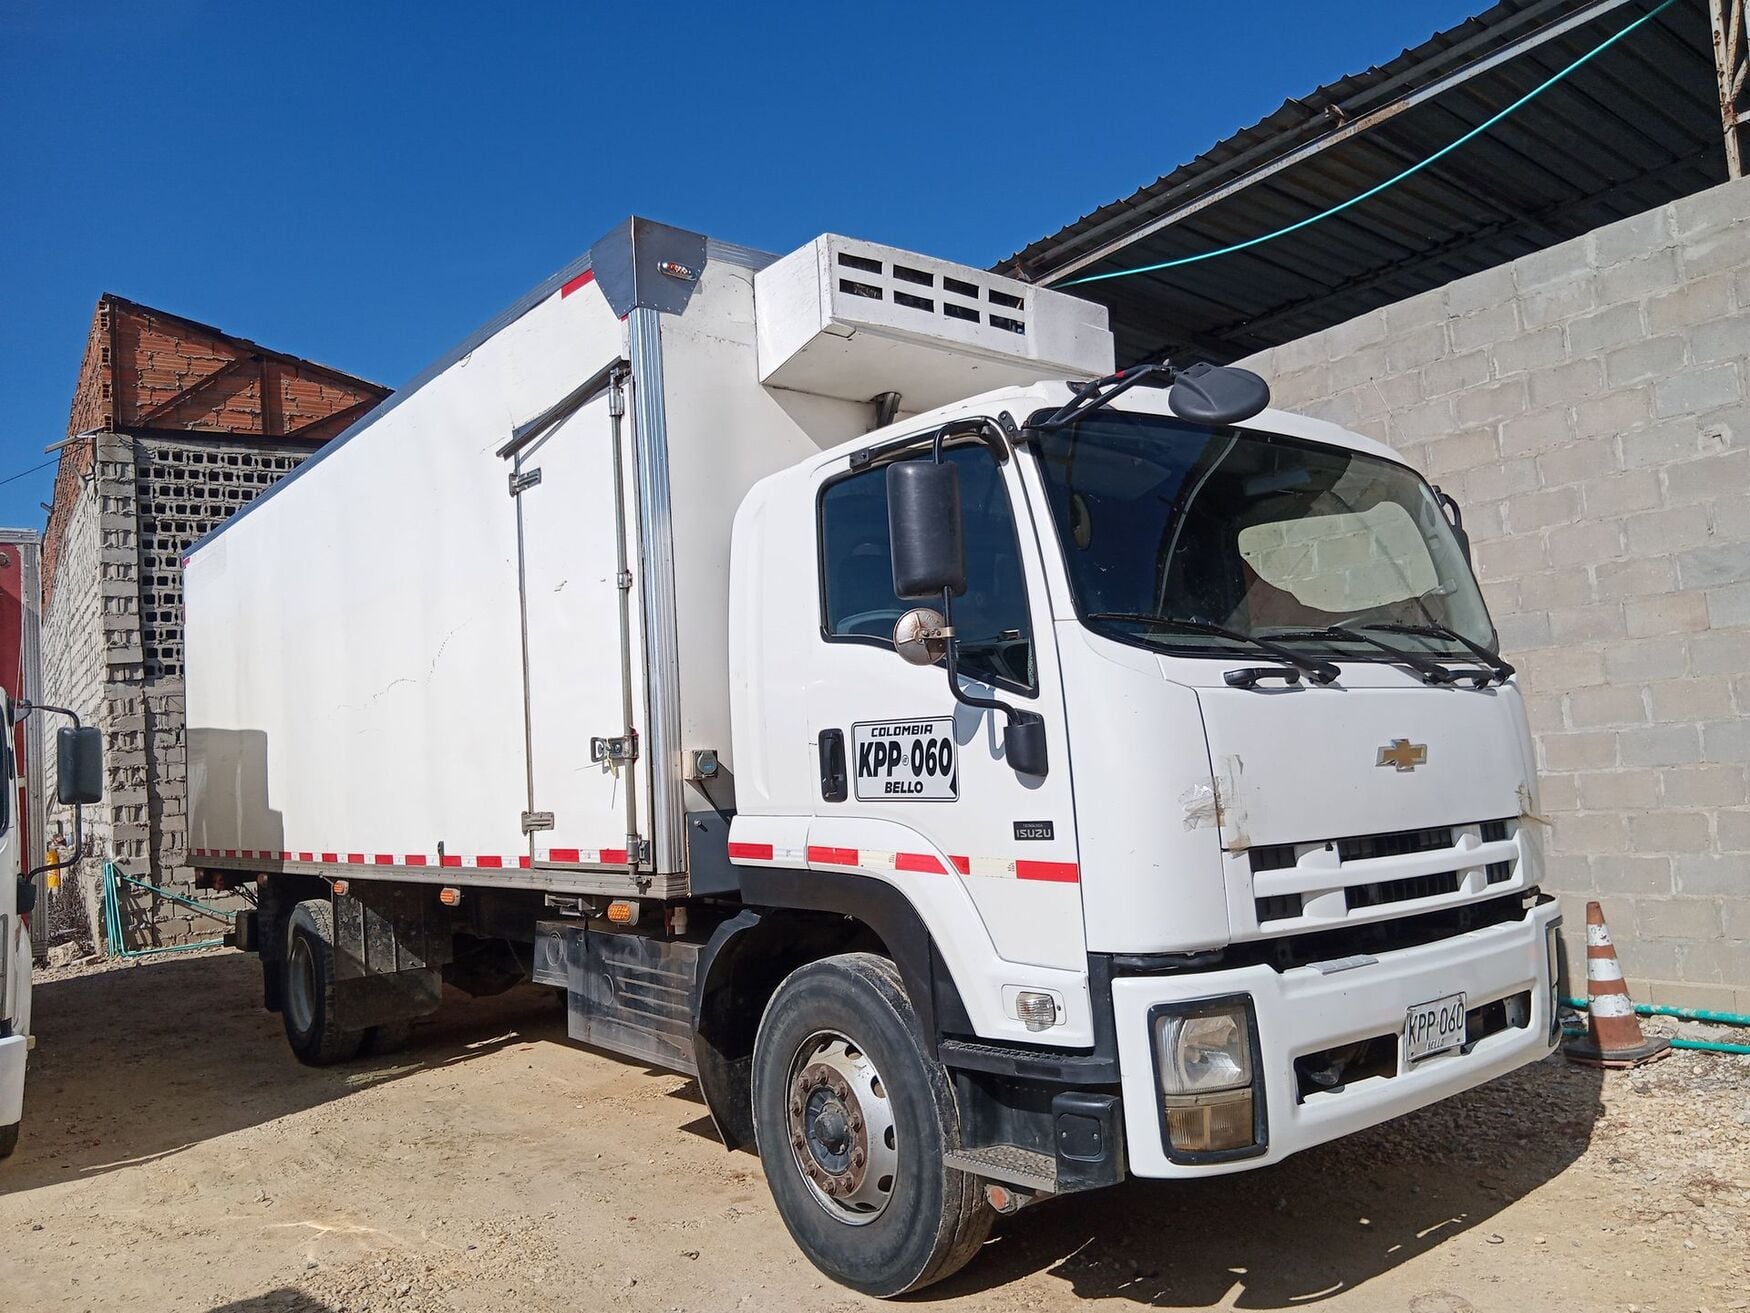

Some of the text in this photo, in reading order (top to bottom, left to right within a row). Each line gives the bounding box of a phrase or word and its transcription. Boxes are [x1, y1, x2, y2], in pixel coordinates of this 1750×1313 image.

[871, 724, 933, 737] COLOMBIA
[858, 737, 953, 777] KPP 060
[884, 781, 924, 794] BELLO
[1016, 829, 1051, 838] ISUZU
[1440, 1002, 1465, 1036] 060
